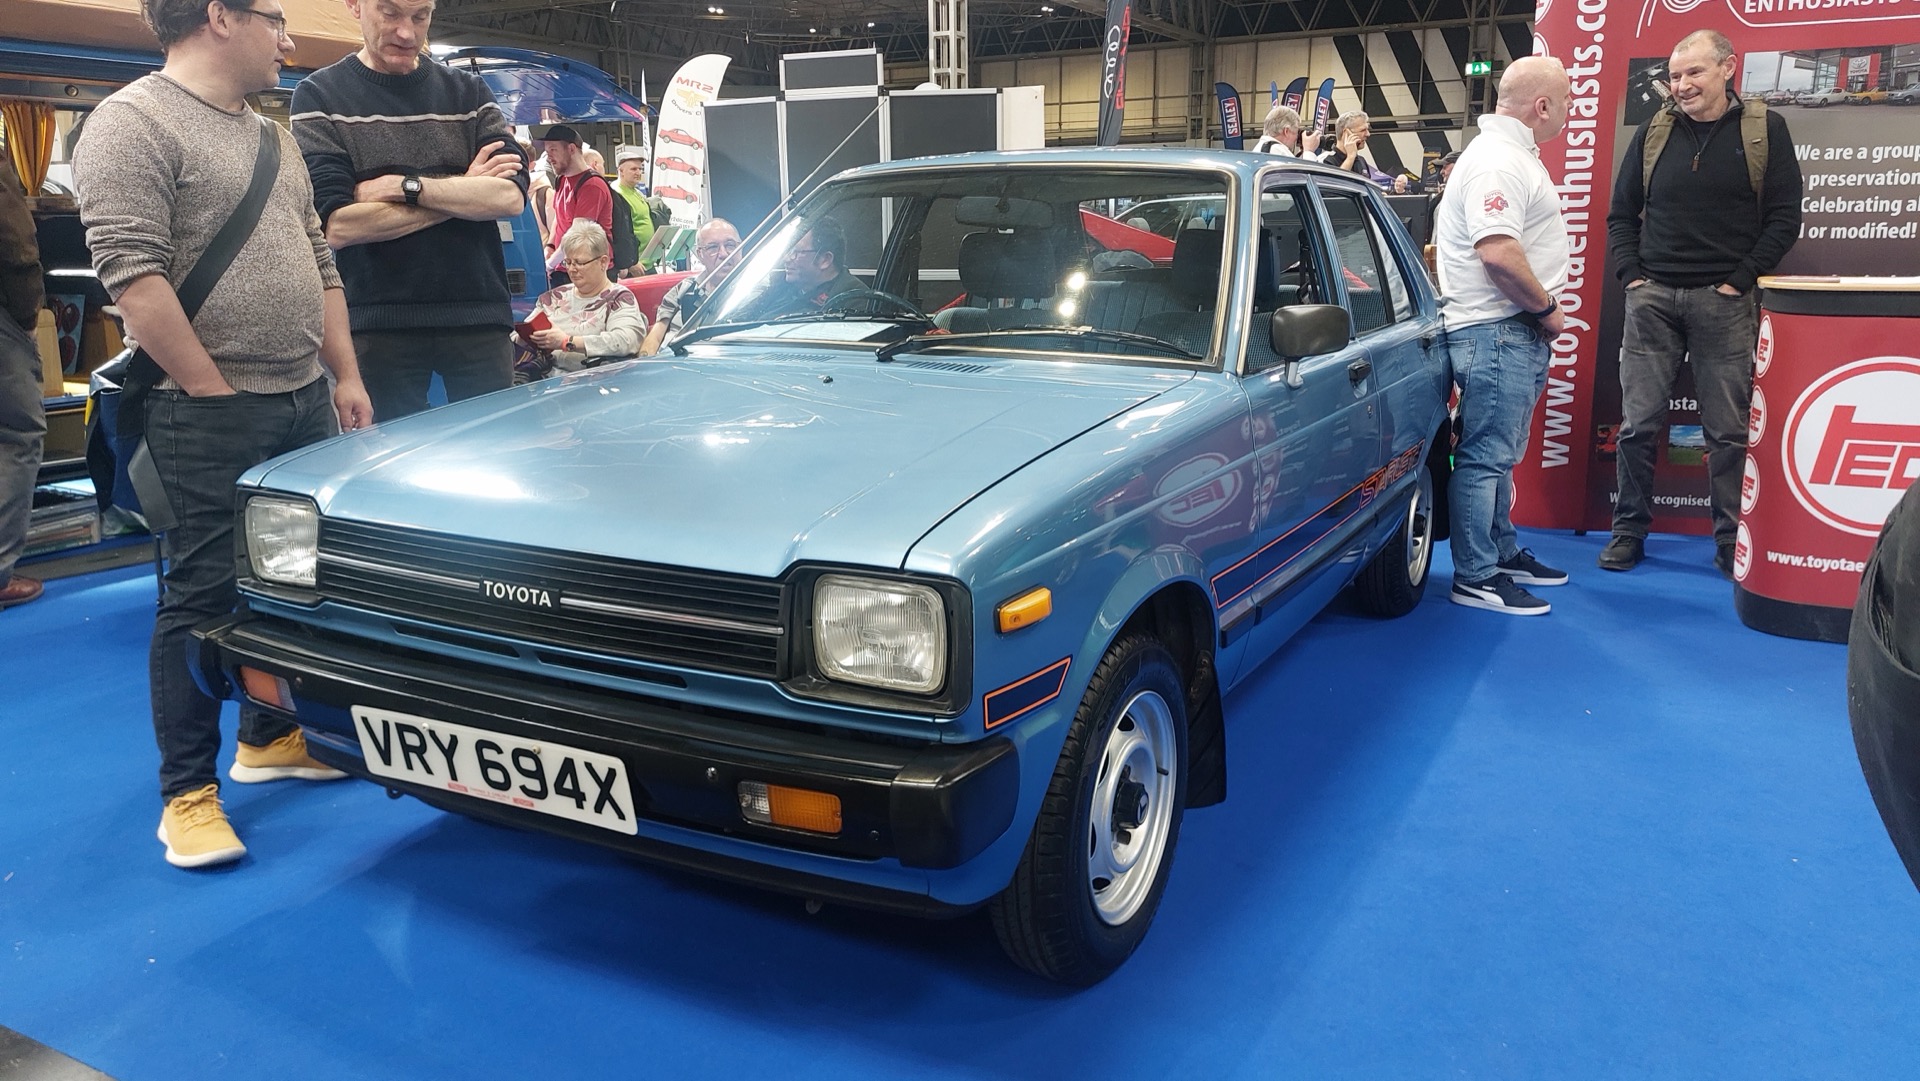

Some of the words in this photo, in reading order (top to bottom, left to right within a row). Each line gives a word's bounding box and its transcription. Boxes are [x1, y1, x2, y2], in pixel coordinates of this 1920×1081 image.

[1224, 101, 1239, 135] SEALEY
[1794, 144, 1821, 161] We
[1824, 147, 1854, 160] are
[1857, 146, 1868, 160] a
[1808, 168, 1920, 191] preservation
[1801, 195, 1903, 217] Celebrating
[1808, 226, 1827, 239] or
[1830, 222, 1918, 239] modified!
[1610, 492, 1620, 503] W
[483, 579, 552, 607] TOYOTA
[360, 715, 459, 783] VRY
[474, 738, 627, 822] 694X
